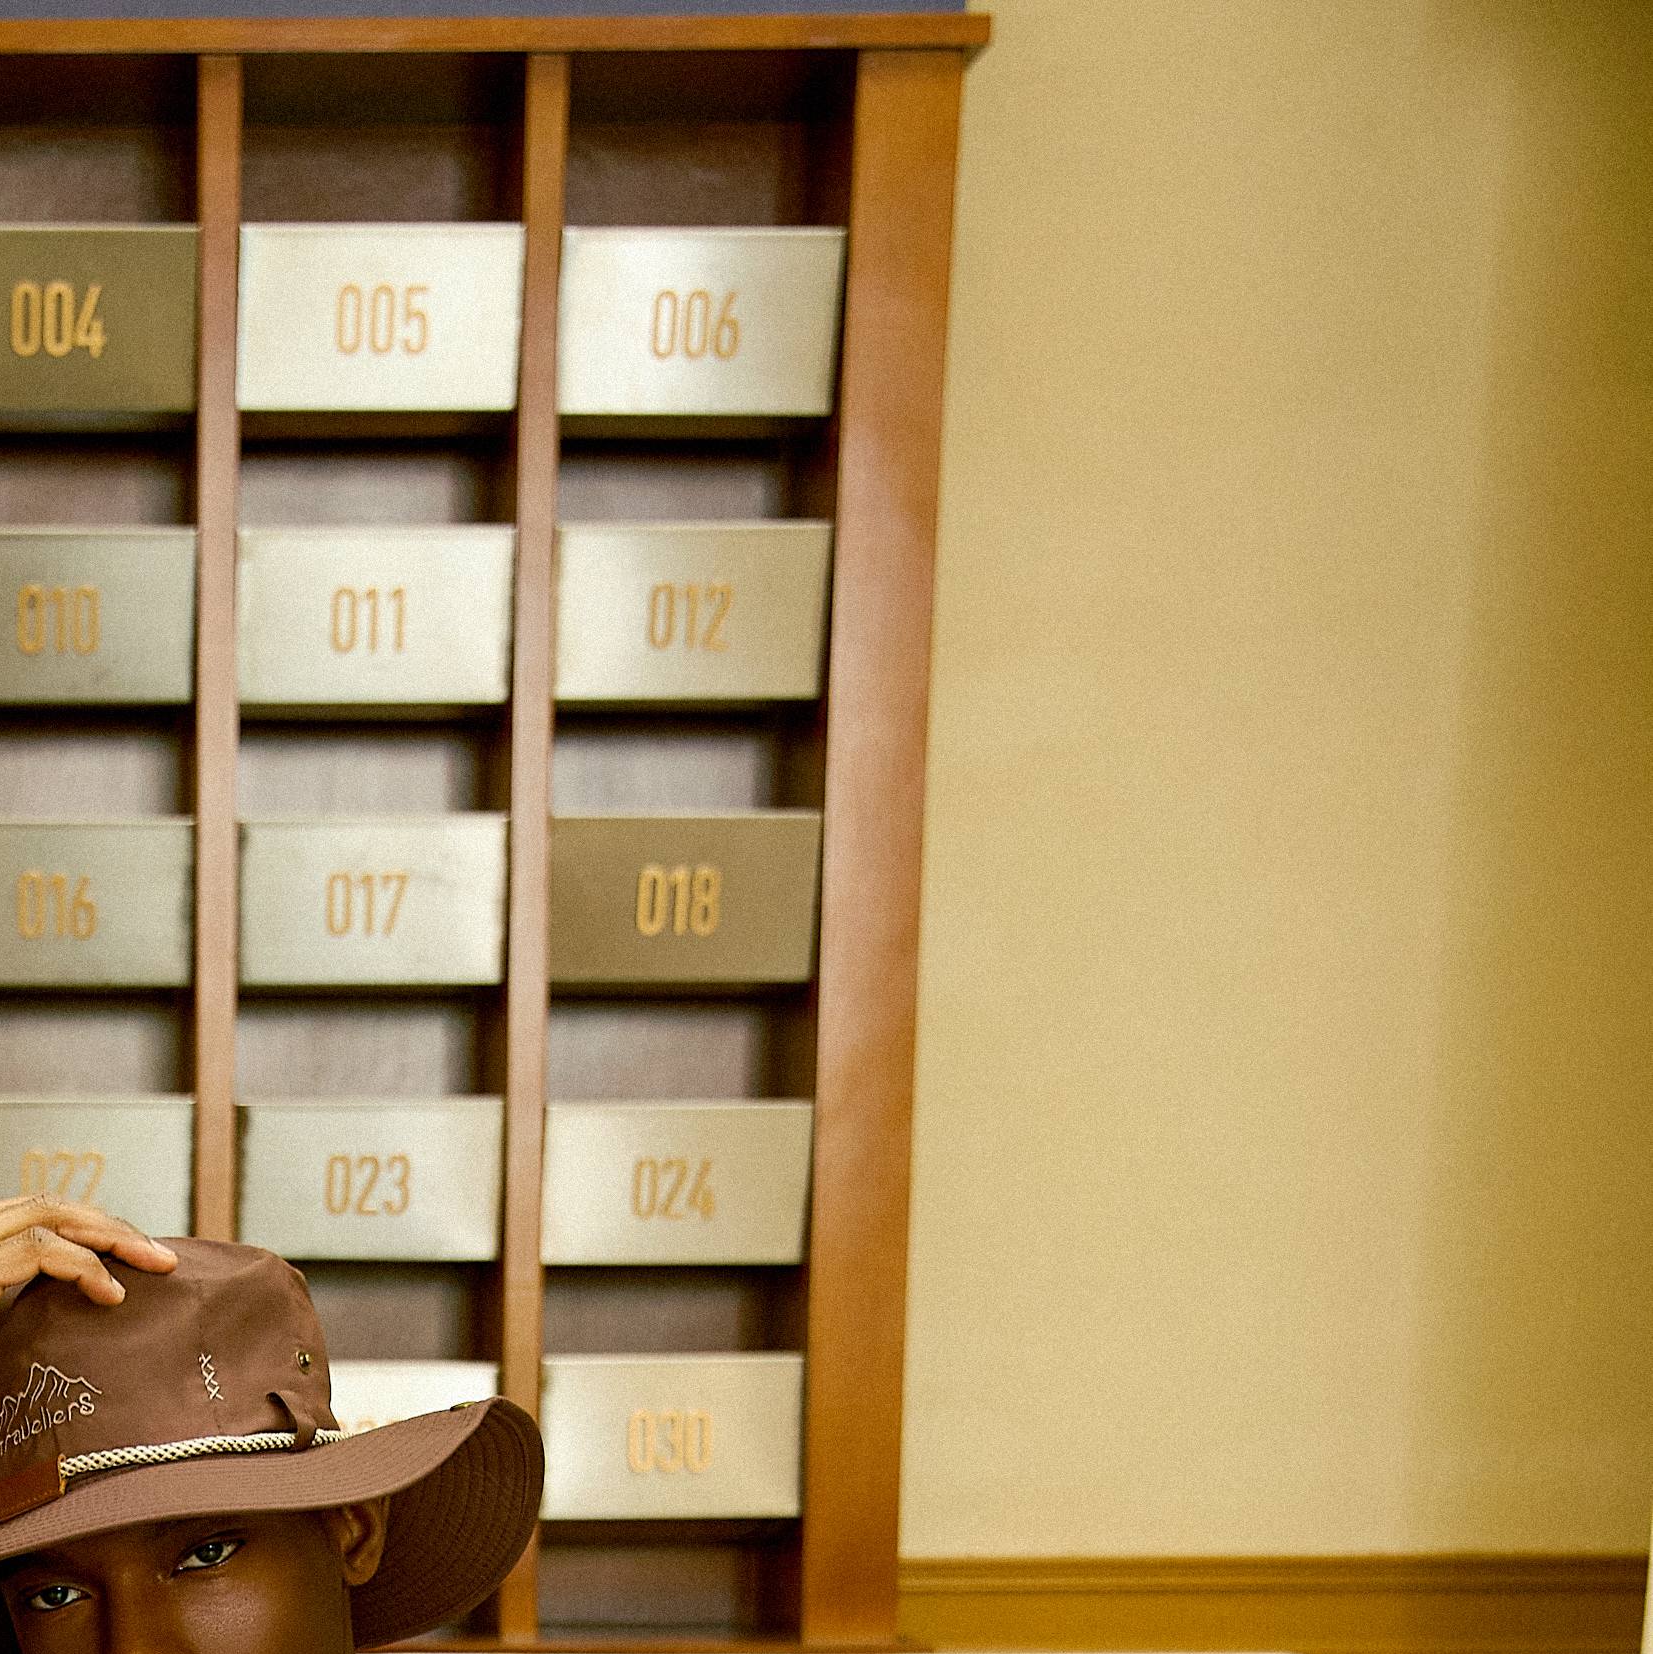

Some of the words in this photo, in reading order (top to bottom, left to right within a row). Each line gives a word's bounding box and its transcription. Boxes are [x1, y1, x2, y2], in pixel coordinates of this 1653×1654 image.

[10, 281, 106, 359] 004
[334, 283, 430, 357] 005
[651, 289, 742, 361] 006
[18, 584, 100, 654] 010
[330, 586, 407, 654] 011
[648, 583, 733, 652] 012
[17, 872, 97, 941] 016
[325, 872, 409, 938] 017
[636, 864, 721, 936] 018
[325, 1154, 410, 1216] 023
[631, 1159, 716, 1223] 024
[629, 1409, 712, 1474] 030
